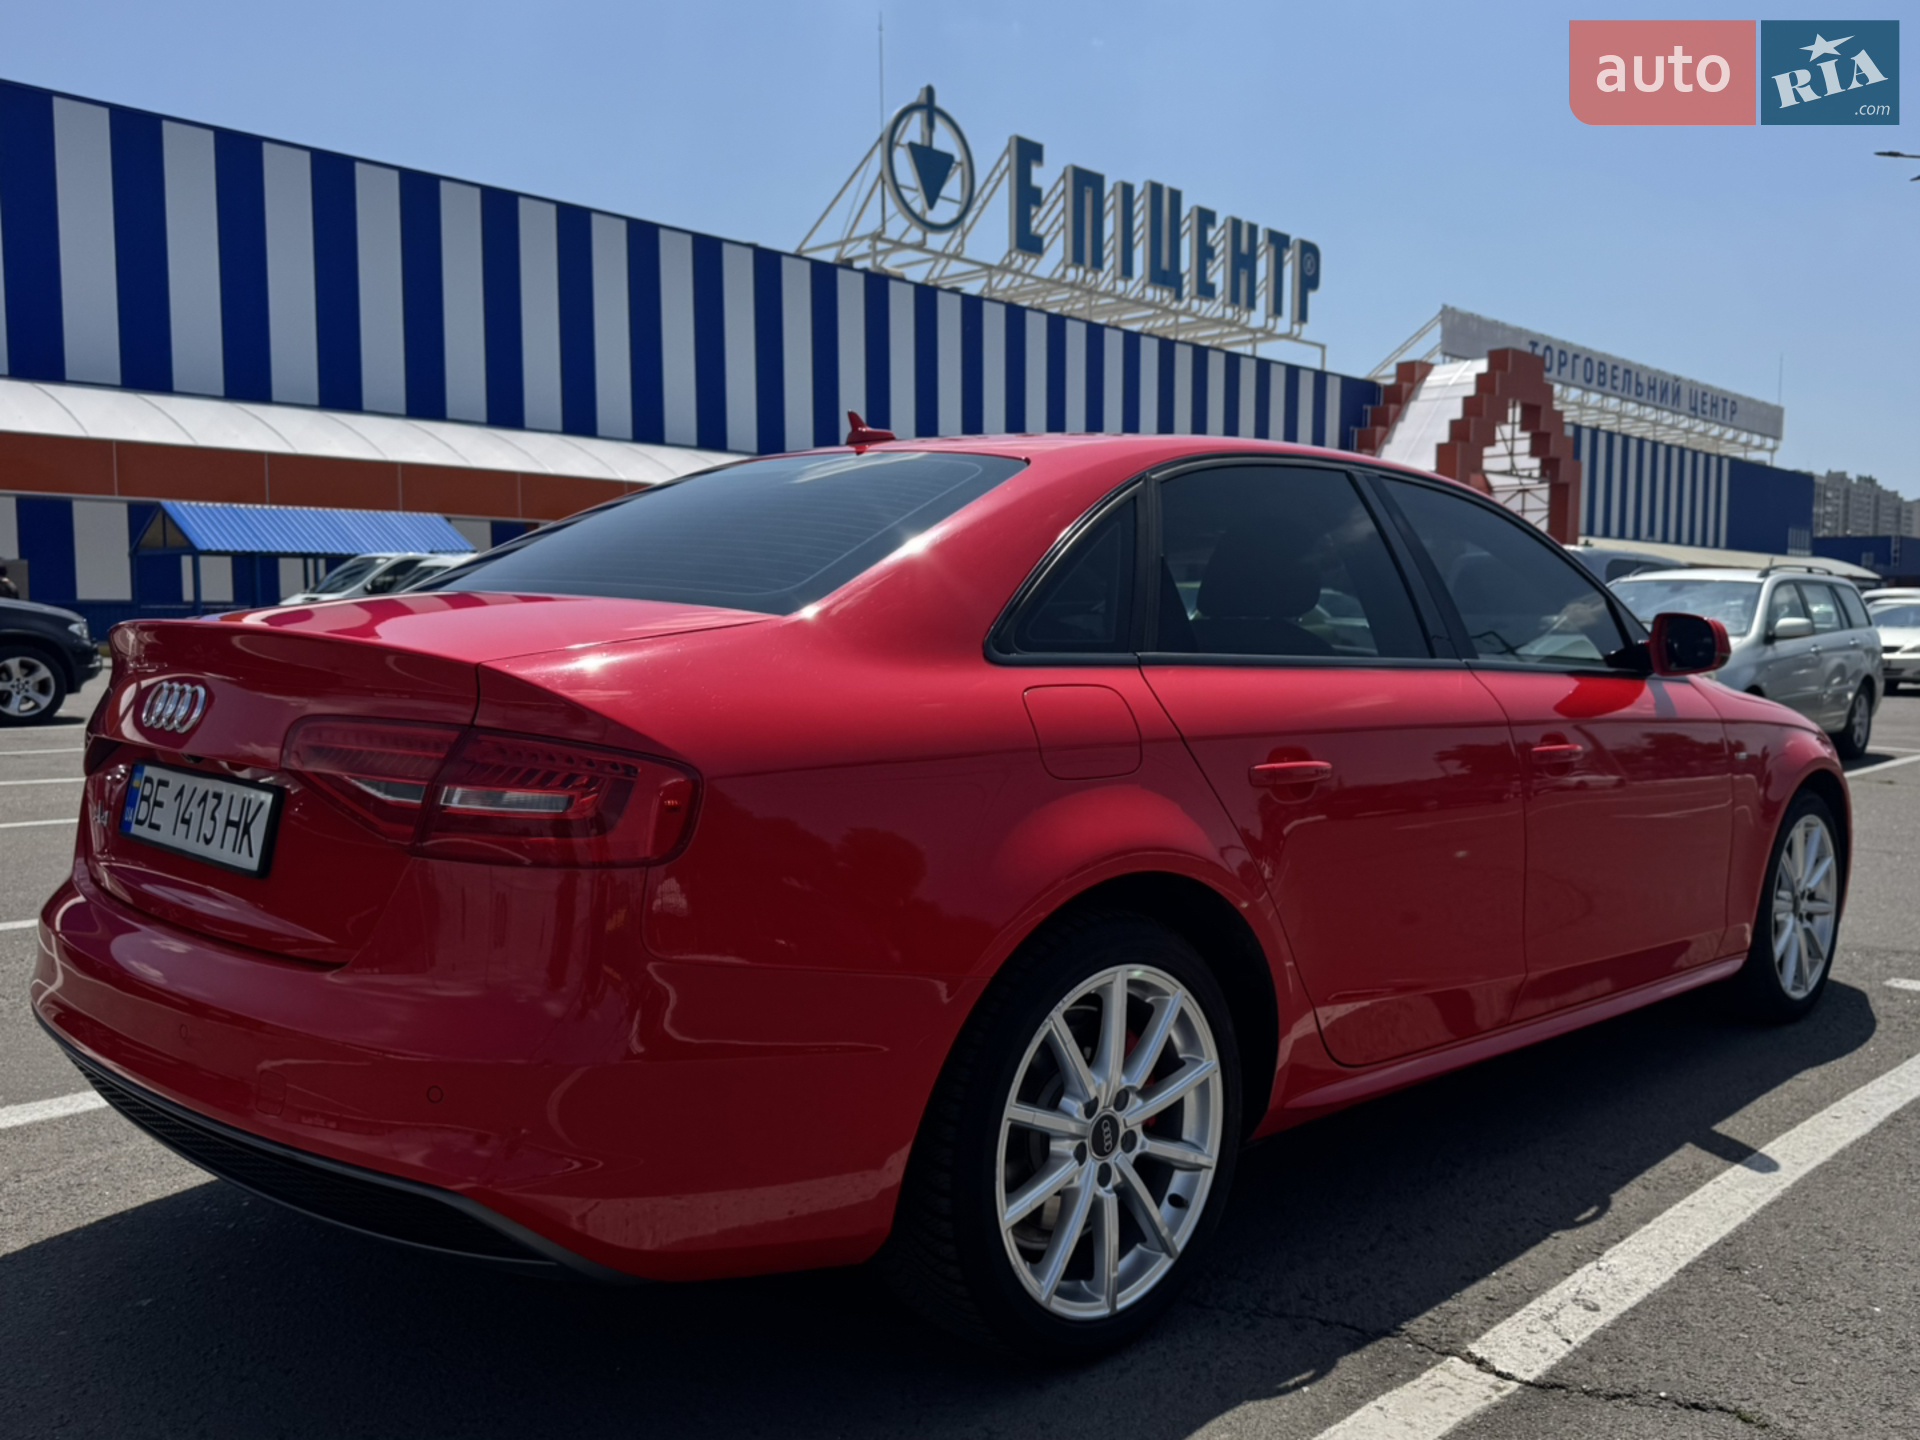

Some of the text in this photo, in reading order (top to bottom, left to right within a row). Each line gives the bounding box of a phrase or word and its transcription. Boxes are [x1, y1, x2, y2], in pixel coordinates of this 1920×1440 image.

[1009, 134, 1320, 323] ЕПІЦЕНТР
[1689, 387, 1738, 422] ЦЕНТР
[135, 775, 170, 832] BE
[173, 783, 223, 846] 1413
[220, 793, 265, 859] HK
